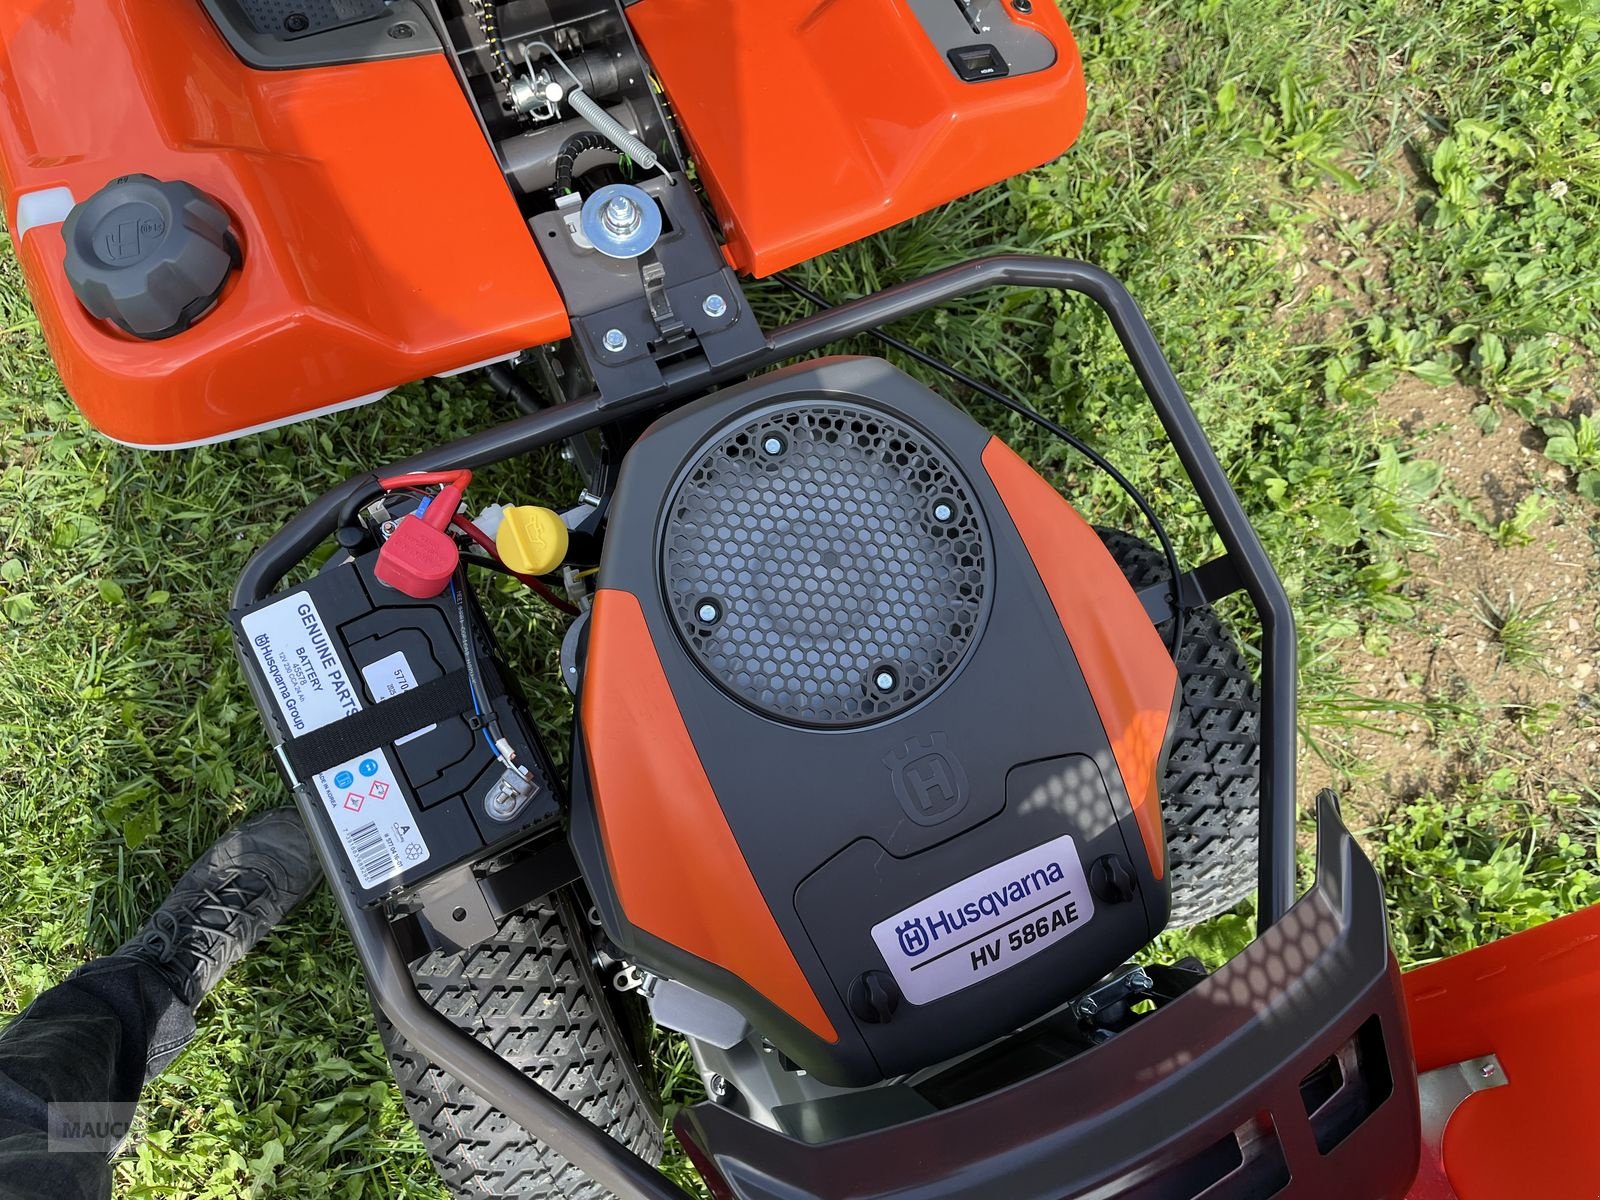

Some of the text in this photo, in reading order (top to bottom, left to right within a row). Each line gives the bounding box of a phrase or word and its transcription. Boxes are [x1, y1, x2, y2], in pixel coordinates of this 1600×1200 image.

[284, 662, 292, 674] 230
[289, 673, 298, 688] CCA
[295, 687, 301, 695] 24
[293, 663, 307, 686] 45578
[296, 647, 323, 691] BATTERY
[298, 604, 359, 717] GENUINE PARTS
[394, 669, 409, 690] 5770
[261, 645, 290, 699] Husqvarna
[286, 698, 304, 730] Group
[325, 788, 337, 808] KOREA
[926, 862, 1065, 941] Husqvarna
[970, 901, 1079, 971] HV 586AE
